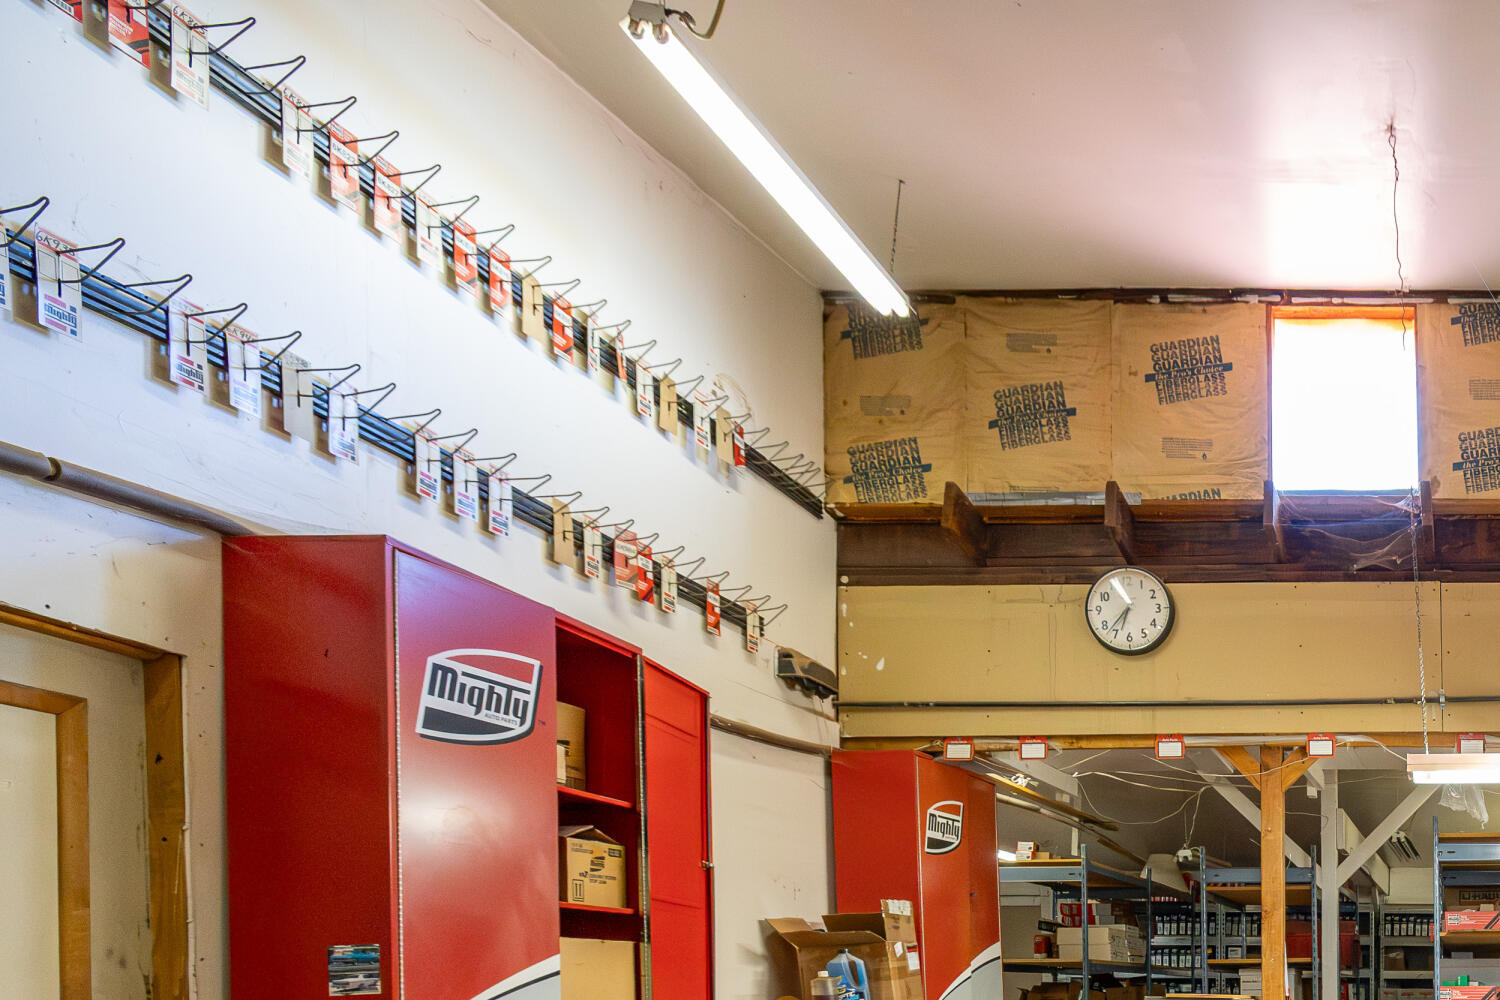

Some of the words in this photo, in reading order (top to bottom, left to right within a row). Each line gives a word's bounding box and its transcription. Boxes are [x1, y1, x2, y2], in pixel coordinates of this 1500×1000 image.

[1100, 592, 1110, 601] 10
[1150, 590, 1157, 599] 2
[1095, 606, 1102, 615] 9
[1155, 604, 1161, 613] 3
[1101, 621, 1108, 630] 8
[1150, 618, 1157, 628] 4
[1112, 629, 1119, 639] 7
[1126, 632, 1133, 642] 6
[1141, 629, 1148, 638] 5
[427, 662, 531, 728] Mighty
[927, 812, 960, 840] Mighty
